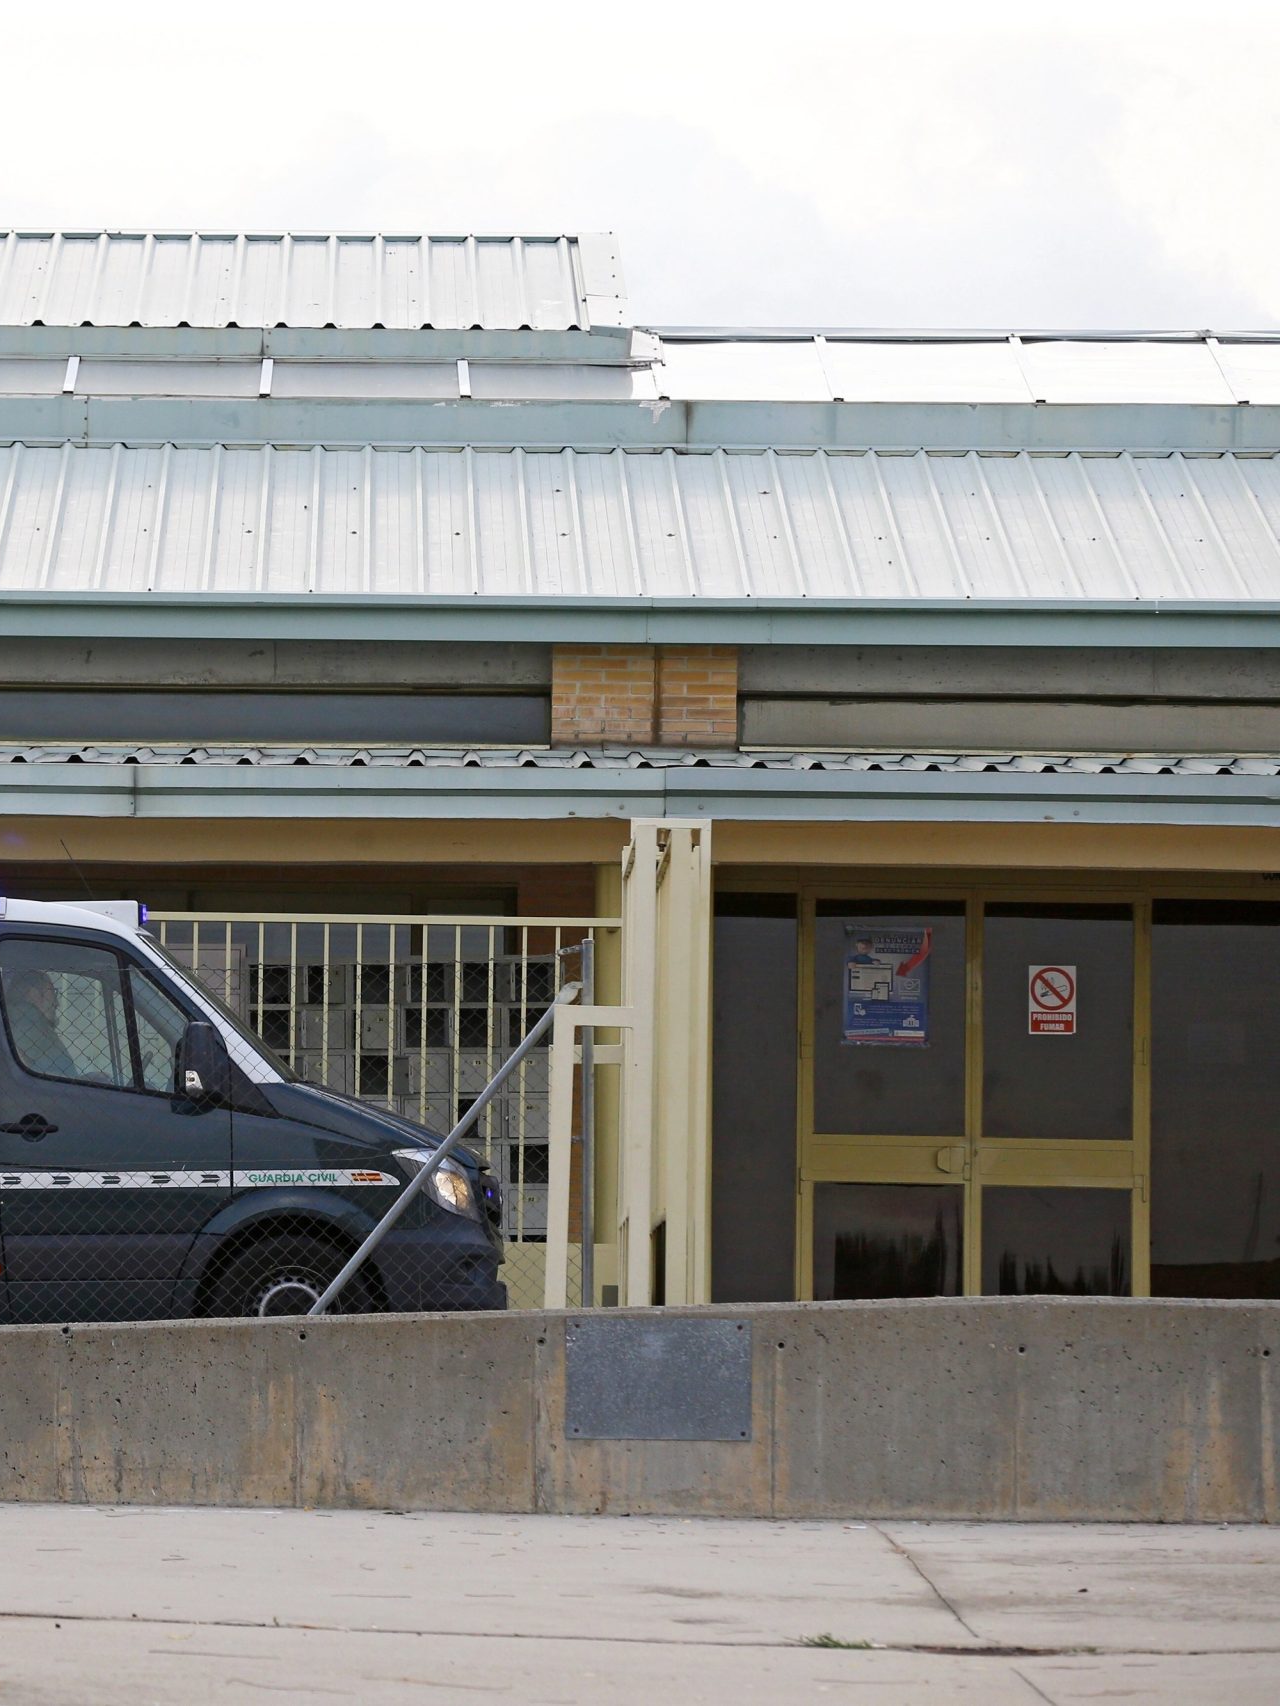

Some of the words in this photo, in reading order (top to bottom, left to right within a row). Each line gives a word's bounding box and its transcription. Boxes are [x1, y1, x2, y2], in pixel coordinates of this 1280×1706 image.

[1032, 1013, 1073, 1021] PROHIBIDO
[1039, 1023, 1065, 1031] FUMAR
[248, 1173, 304, 1183] GUARDIA
[308, 1172, 338, 1183] CIVIL
